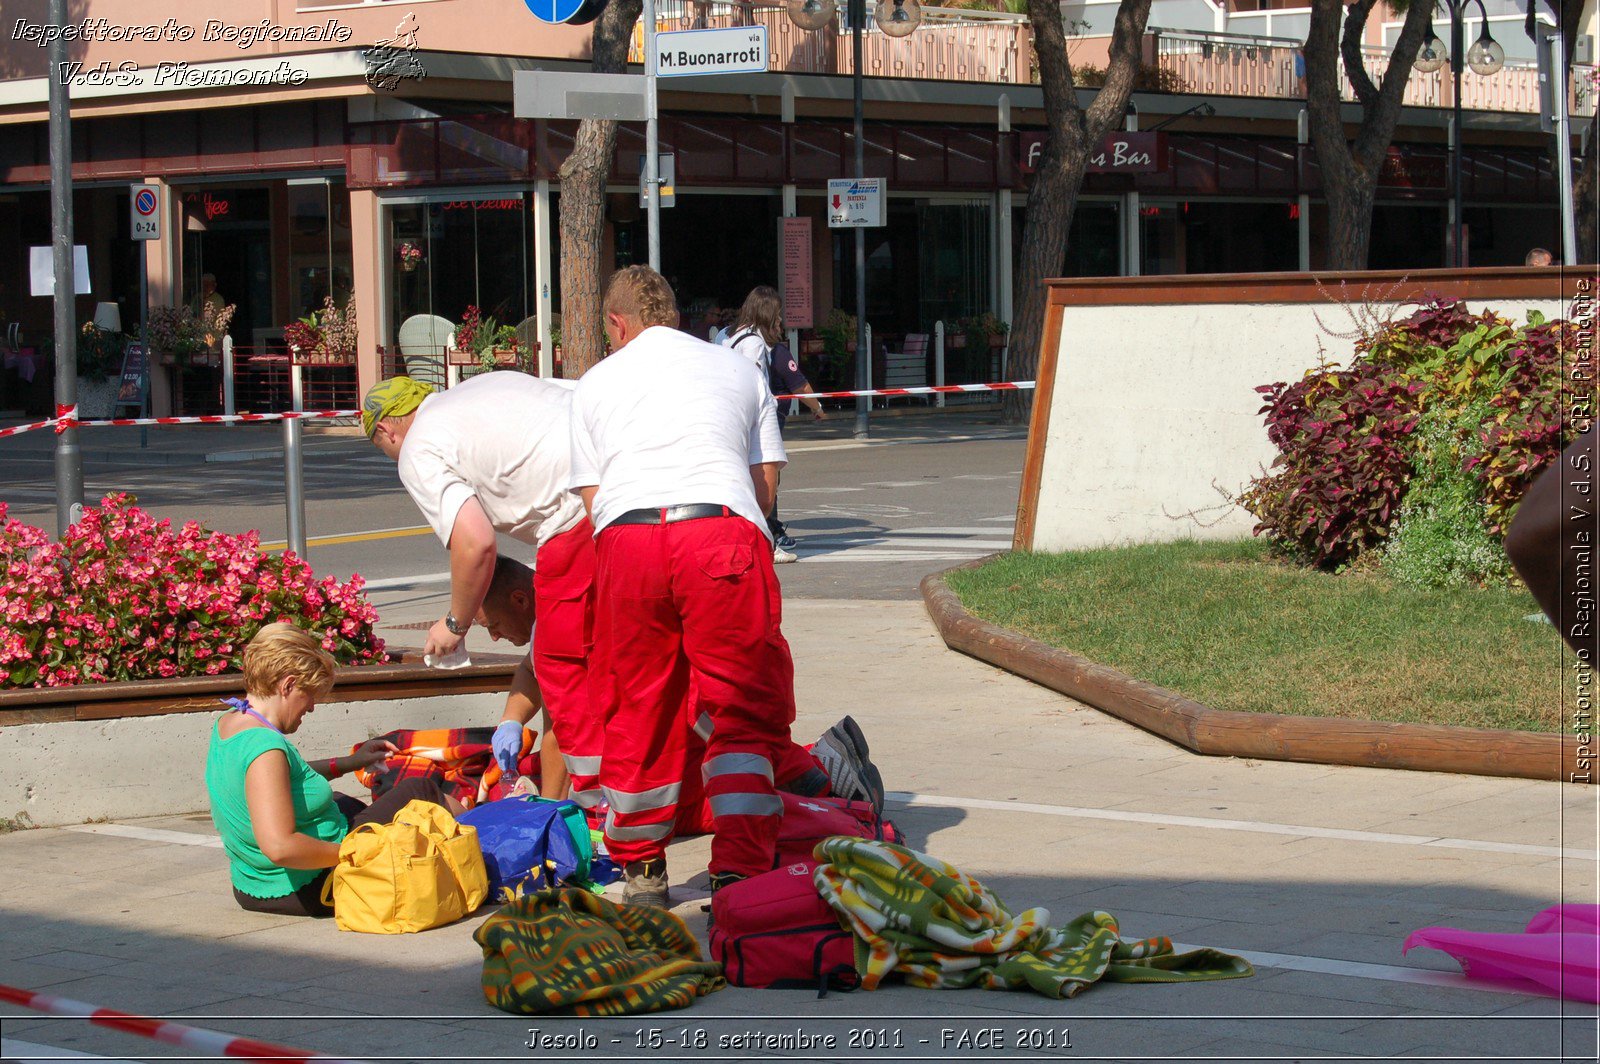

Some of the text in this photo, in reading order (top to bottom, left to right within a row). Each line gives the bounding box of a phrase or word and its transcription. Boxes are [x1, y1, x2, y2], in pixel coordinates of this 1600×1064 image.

[748, 34, 760, 42] via
[660, 47, 760, 67] M.Buonarroti
[1113, 141, 1151, 167] Bar
[136, 222, 156, 233] 0-24
